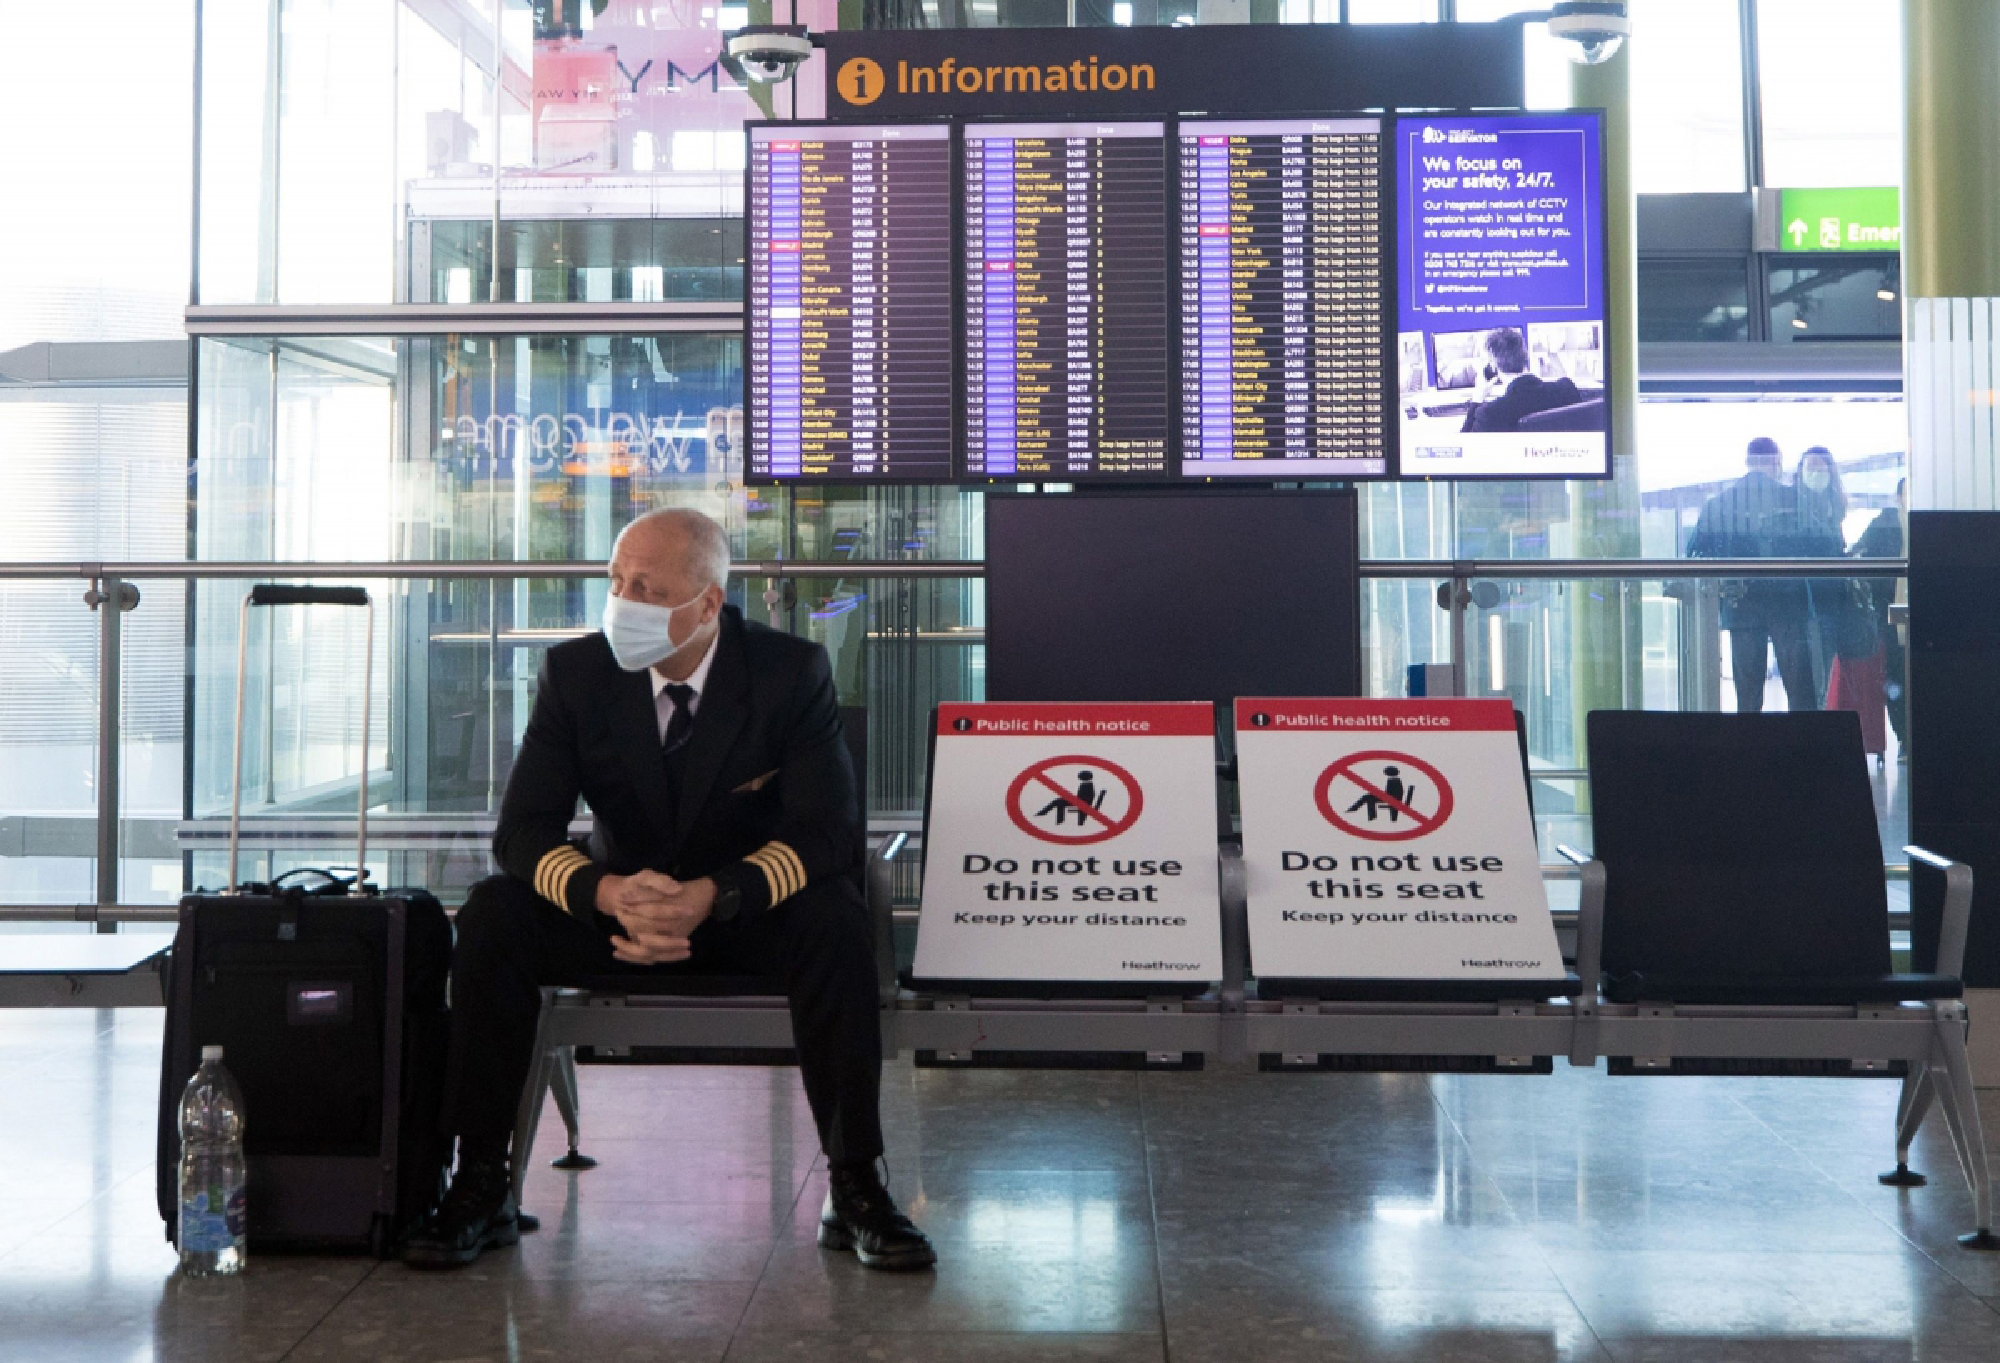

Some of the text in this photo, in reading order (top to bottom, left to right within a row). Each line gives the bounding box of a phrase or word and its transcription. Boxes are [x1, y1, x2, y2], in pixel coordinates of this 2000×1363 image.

[898, 57, 1153, 93] Information
[1422, 157, 1522, 172] We focus on
[1422, 172, 1555, 192] your safety, 24/7.
[1423, 198, 1567, 212] Our integrated network of CCTV
[1423, 213, 1563, 226] operators watch in real time and
[1423, 227, 1571, 239] are constantly looking out for you.
[1847, 222, 1902, 243] Emer
[976, 719, 1151, 731] Public health notice
[1274, 714, 1451, 726] Public health notice
[962, 854, 1183, 876] Do not use
[1281, 850, 1503, 872] Do not use
[984, 880, 1158, 902] this seat
[1306, 879, 1484, 899] this seat
[954, 912, 1186, 927] Keep your distance
[1282, 910, 1518, 924] Keep your distance
[1121, 960, 1201, 971] Heathrow
[1461, 959, 1541, 969] Heathrow
